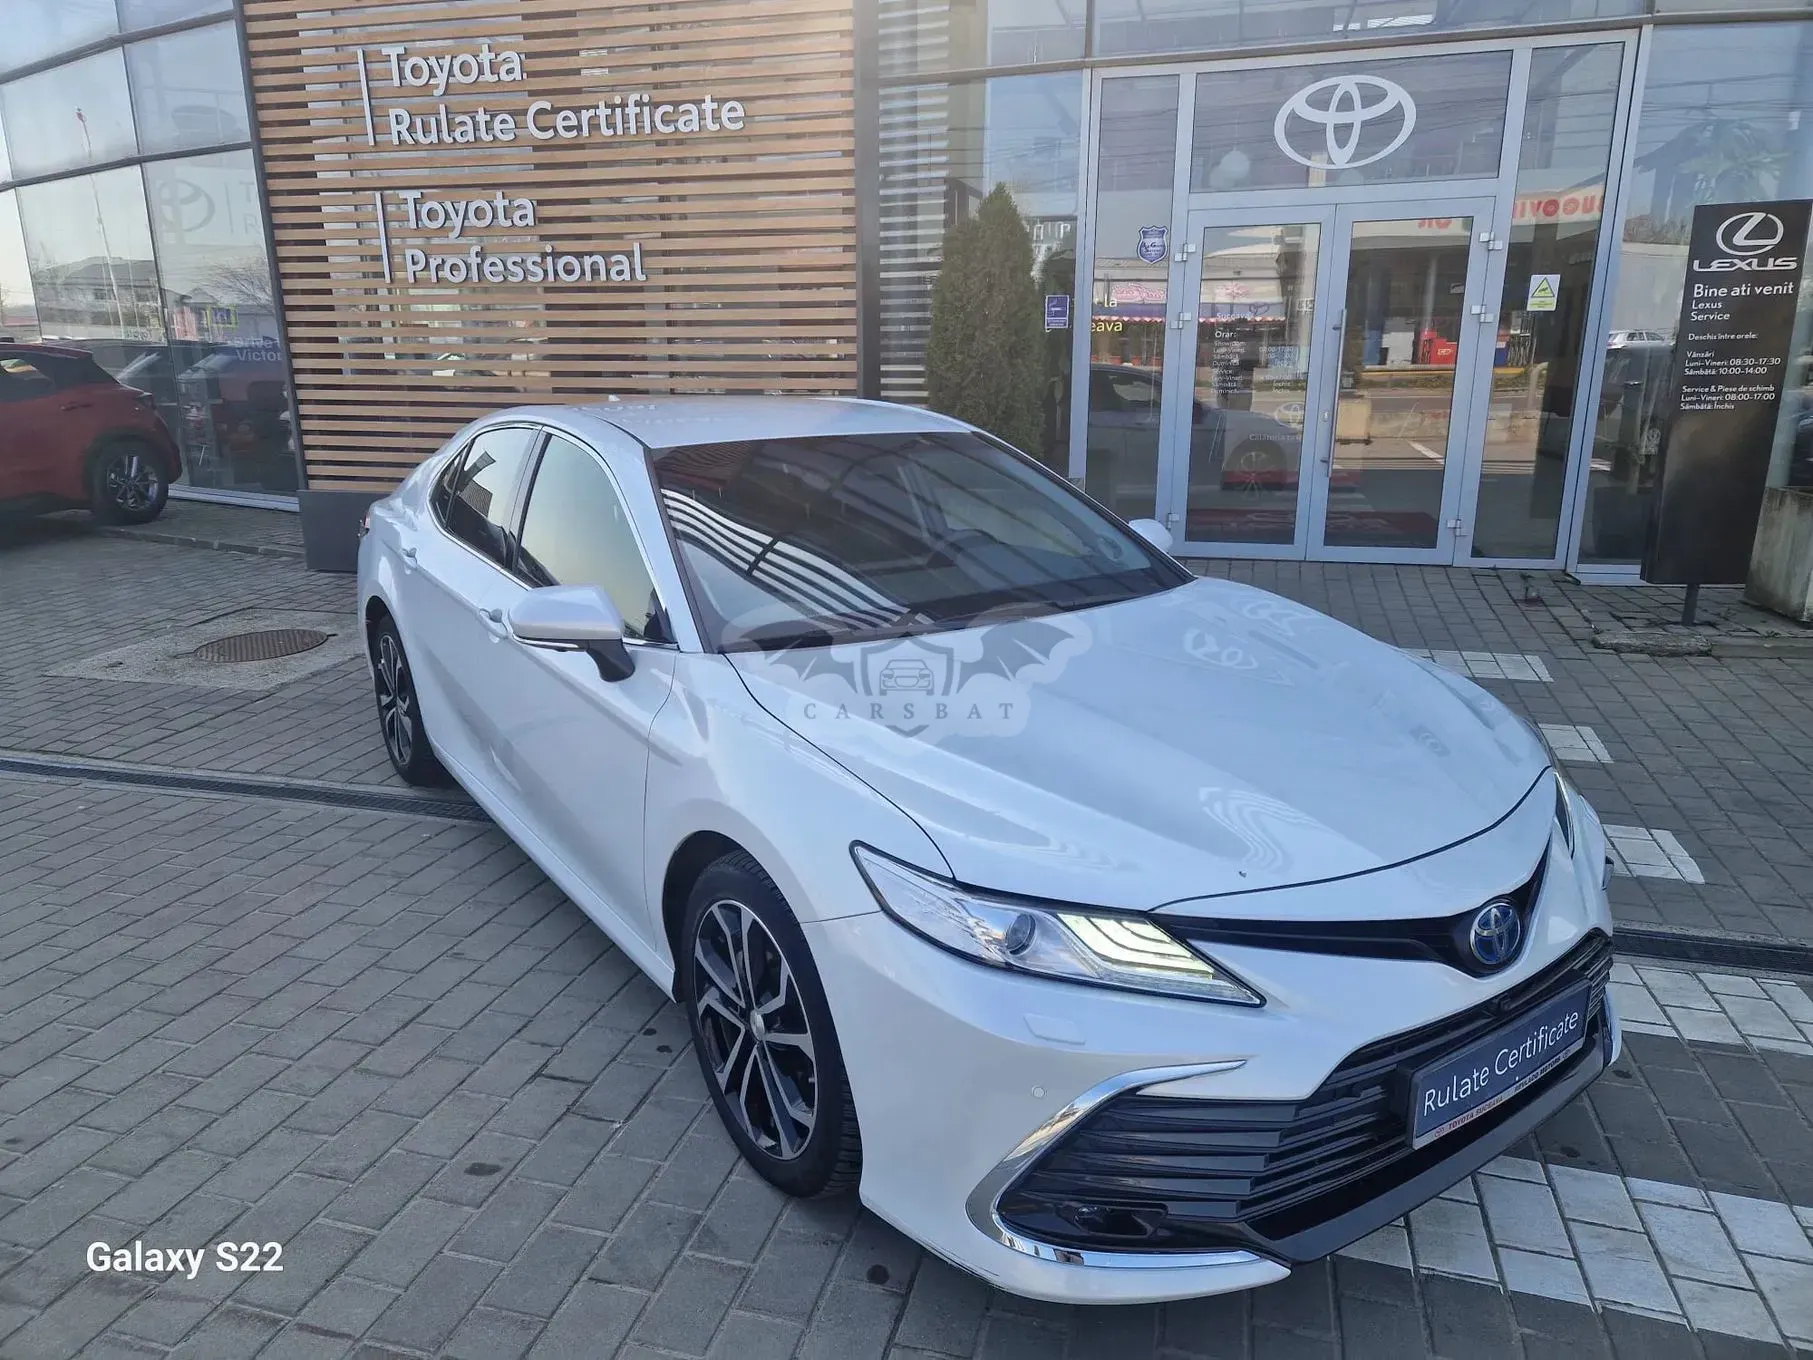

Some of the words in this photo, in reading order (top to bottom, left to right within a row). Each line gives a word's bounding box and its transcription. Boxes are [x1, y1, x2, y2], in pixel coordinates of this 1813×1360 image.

[381, 44, 525, 97] Toyota
[388, 103, 517, 146] Rulate
[526, 93, 746, 141] Certificate
[399, 190, 537, 239] Toyota
[404, 241, 649, 284] Professional
[1693, 257, 1798, 272] LEXUS
[1693, 283, 1728, 298] Bine
[1730, 284, 1751, 297] ati
[1754, 281, 1795, 295] venit
[1104, 294, 1118, 308] la
[1692, 300, 1723, 310] Lexus
[1690, 312, 1731, 321] Service
[1688, 333, 1717, 341] Deschis
[1729, 358, 1781, 366] 08:30-17:30
[1719, 366, 1768, 375] 10:00-14:00
[1682, 385, 1709, 393] Service
[1717, 384, 1738, 392] Piese
[1748, 383, 1775, 391] schimb
[1724, 393, 1776, 401] 08:00-17:00
[1423, 1064, 1490, 1117] Rulate
[1494, 1011, 1579, 1076] Certificate
[1448, 1112, 1474, 1130] TOYOTA
